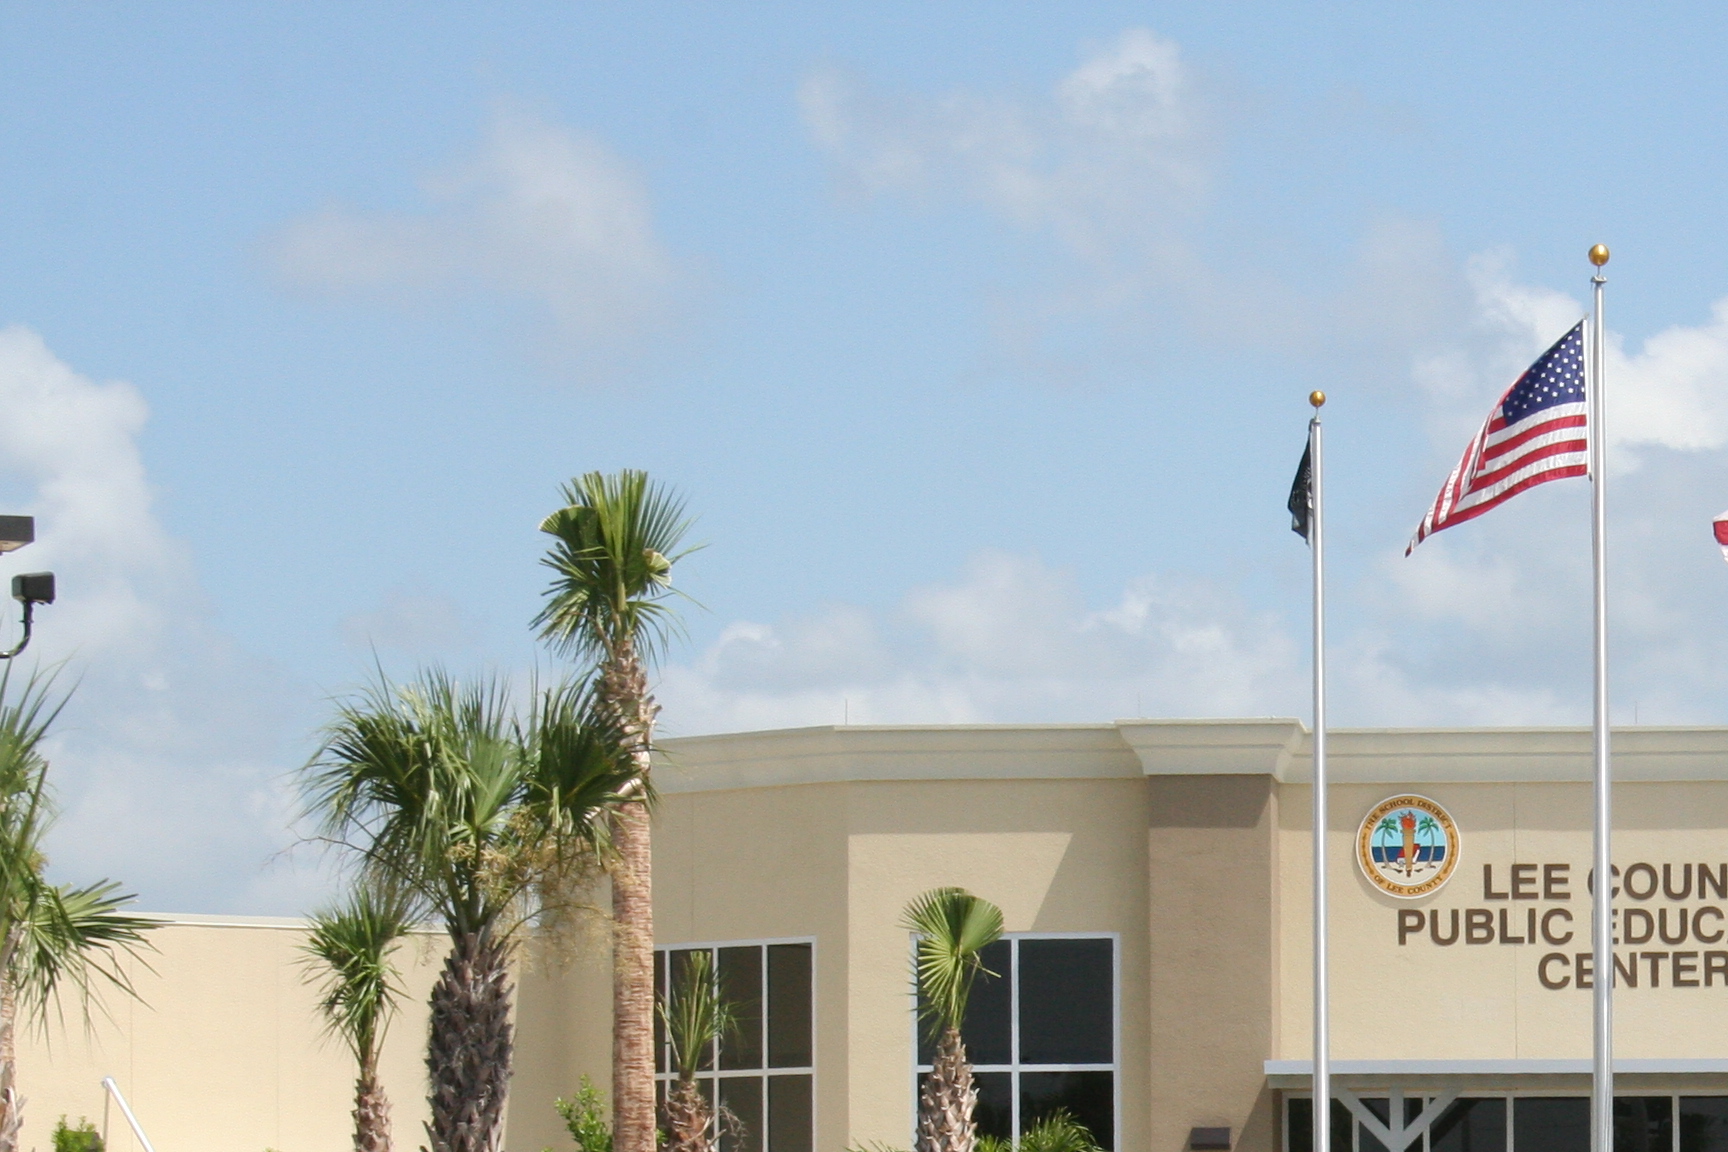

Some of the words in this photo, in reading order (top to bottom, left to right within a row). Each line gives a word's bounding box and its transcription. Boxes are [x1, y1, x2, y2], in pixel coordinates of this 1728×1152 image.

[1365, 814, 1378, 831] THE
[1380, 798, 1415, 814] SCHOOL
[1417, 800, 1452, 829] DISTRICT
[1374, 874, 1384, 885] OF
[1386, 883, 1404, 894] LEE
[1407, 875, 1443, 895] COUNTY
[1484, 863, 1571, 900] LEE
[1398, 908, 1574, 946] PUBLIC
